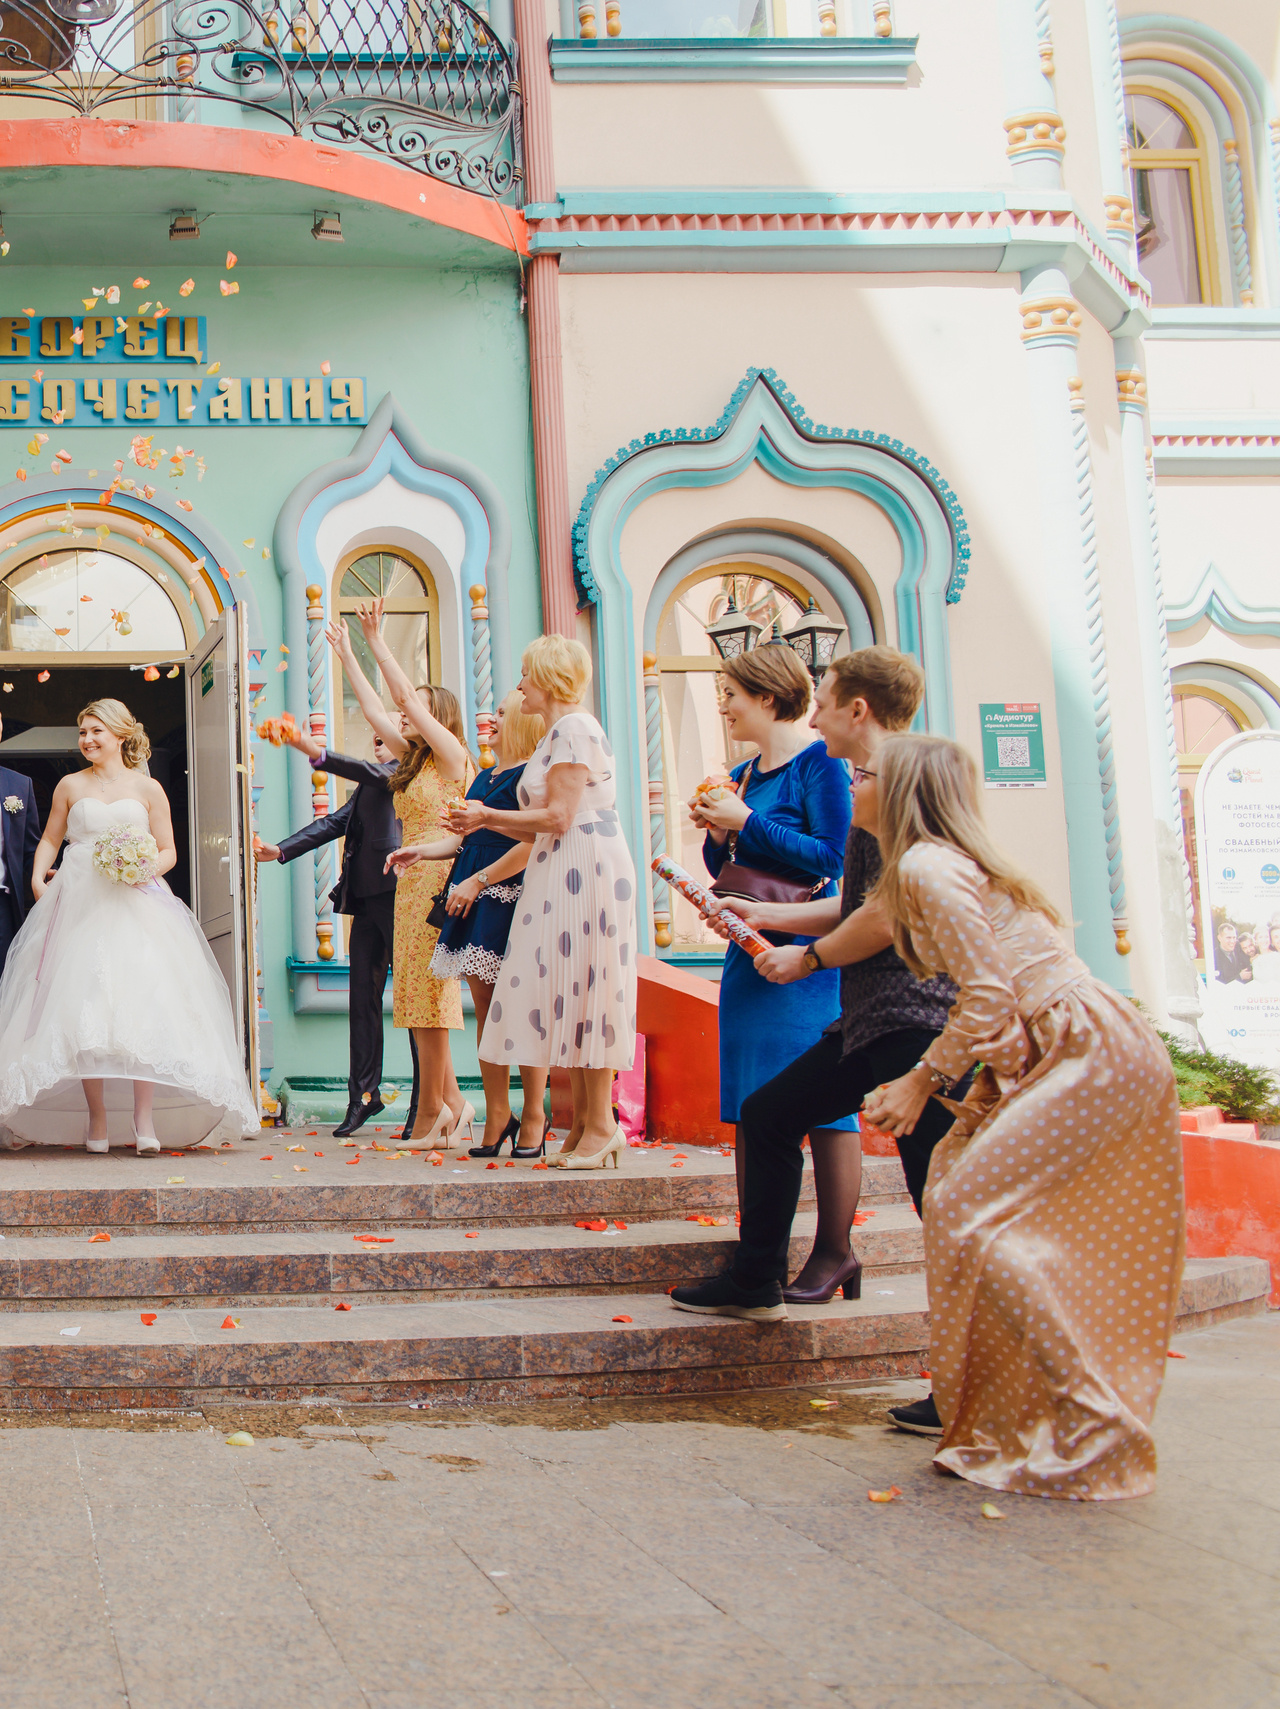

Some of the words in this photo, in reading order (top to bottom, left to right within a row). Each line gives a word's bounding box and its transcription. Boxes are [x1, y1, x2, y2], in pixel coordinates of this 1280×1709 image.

[993, 714, 1034, 722] Аудиотур
[1225, 837, 1280, 846] СВАДЕБНЫЙ
[1247, 996, 1280, 1004] QUESTP
